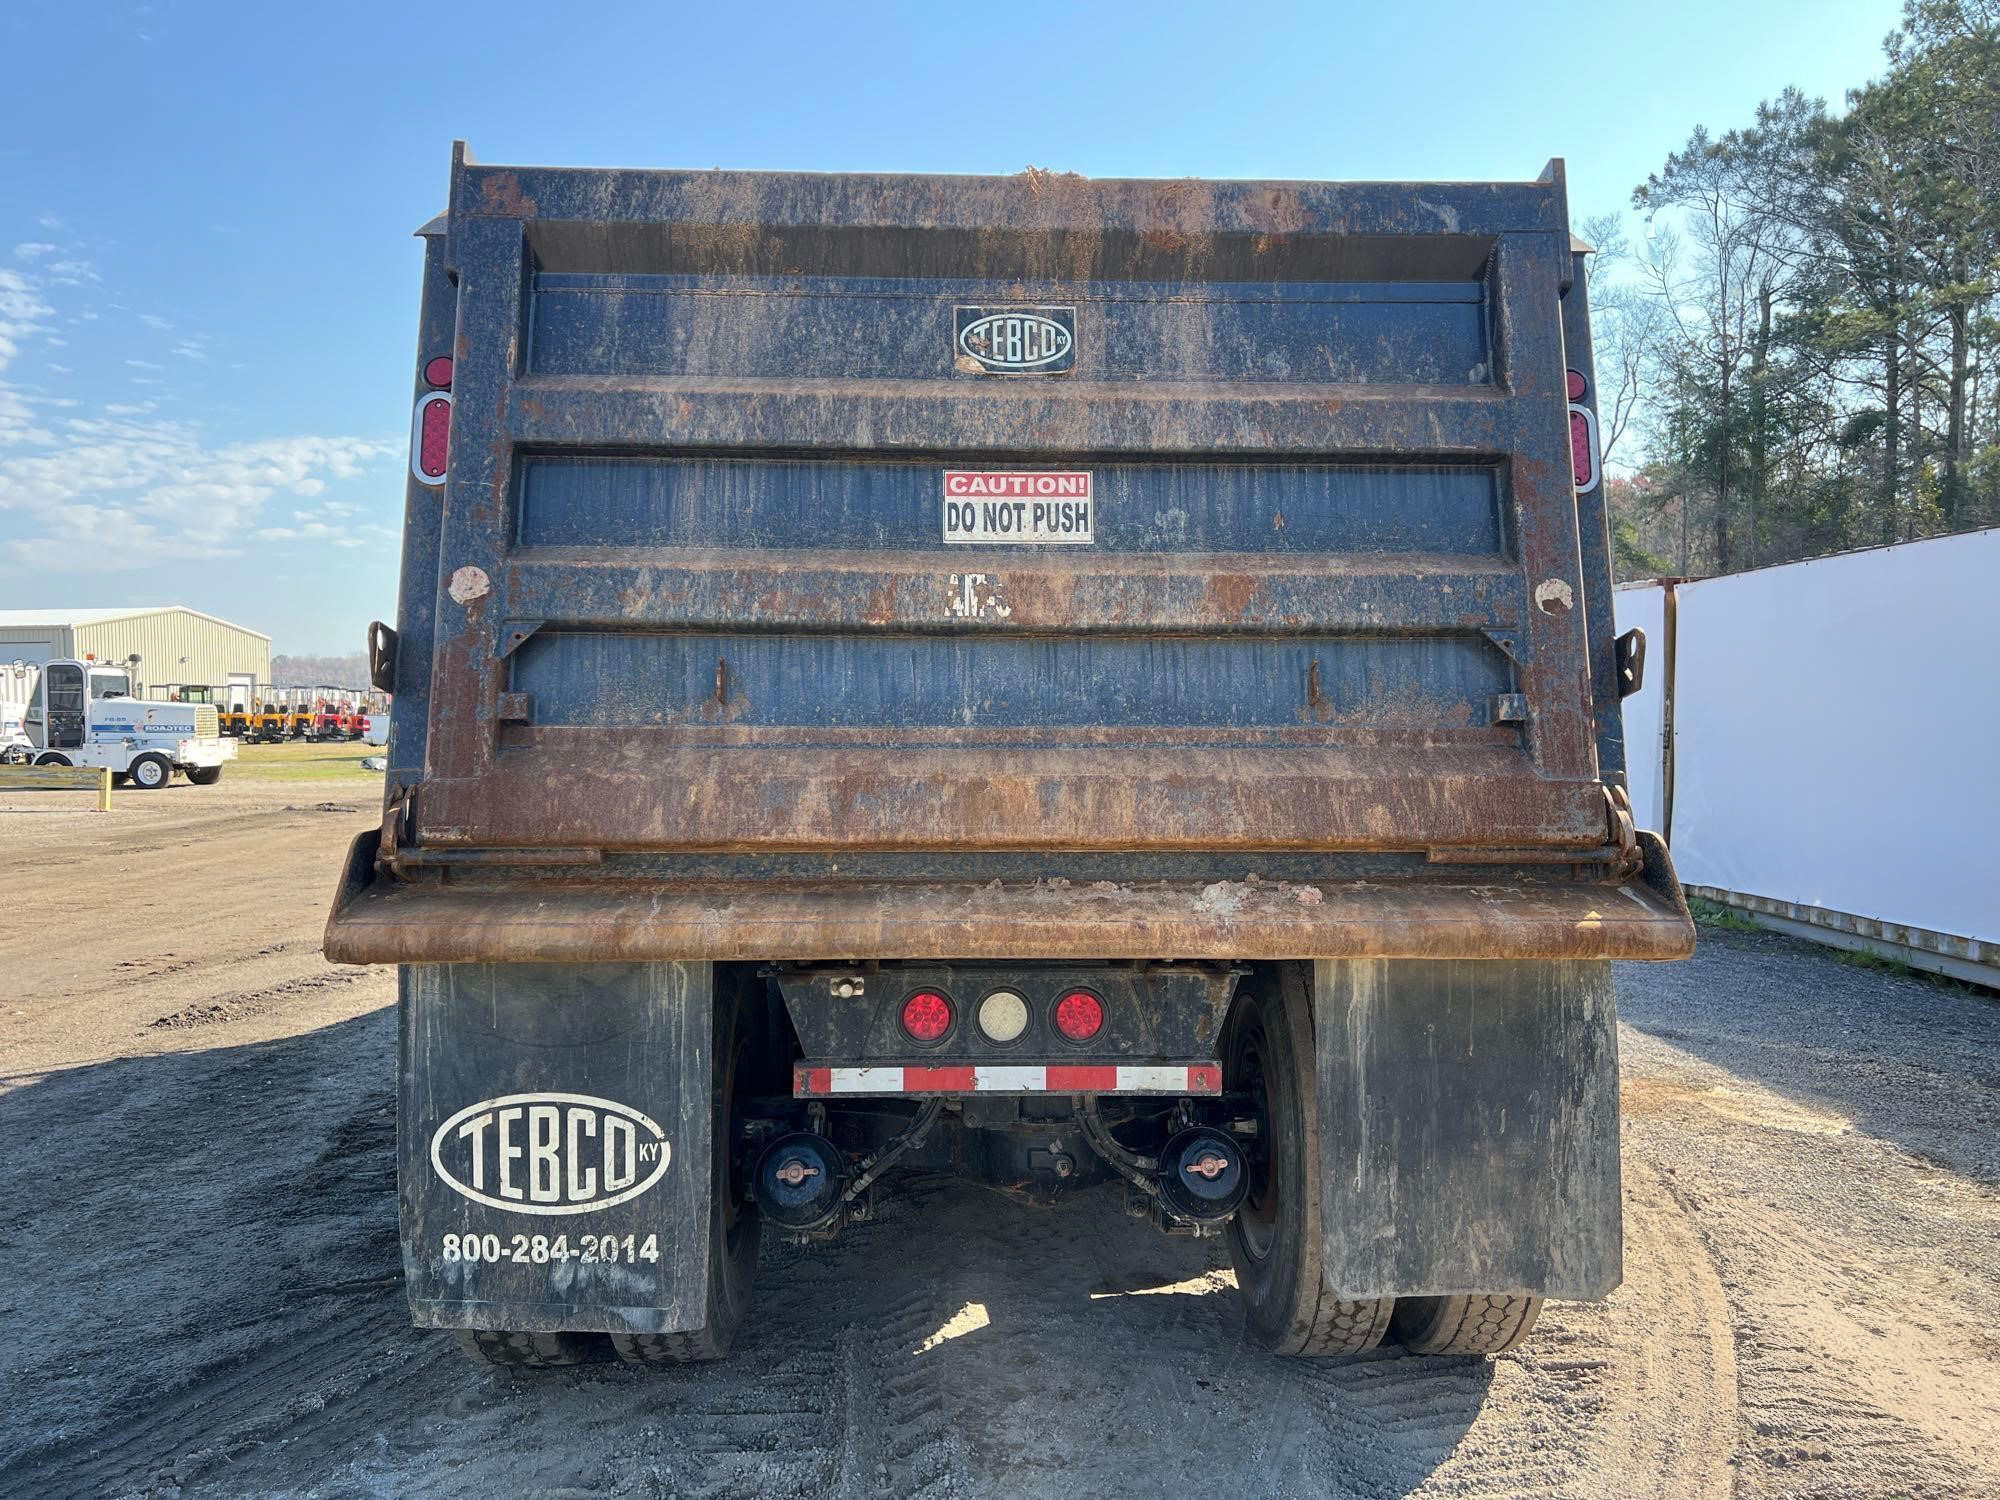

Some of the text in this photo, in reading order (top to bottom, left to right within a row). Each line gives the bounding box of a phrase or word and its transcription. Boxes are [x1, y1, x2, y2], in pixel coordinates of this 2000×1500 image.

[973, 319, 1066, 361] TEBCO KY
[950, 476, 1085, 494] CAUTION!
[947, 502, 1089, 533] DO NOT PUSH
[459, 1106, 658, 1202] TEBCO KY
[442, 1233, 660, 1264] 800-284-2014
